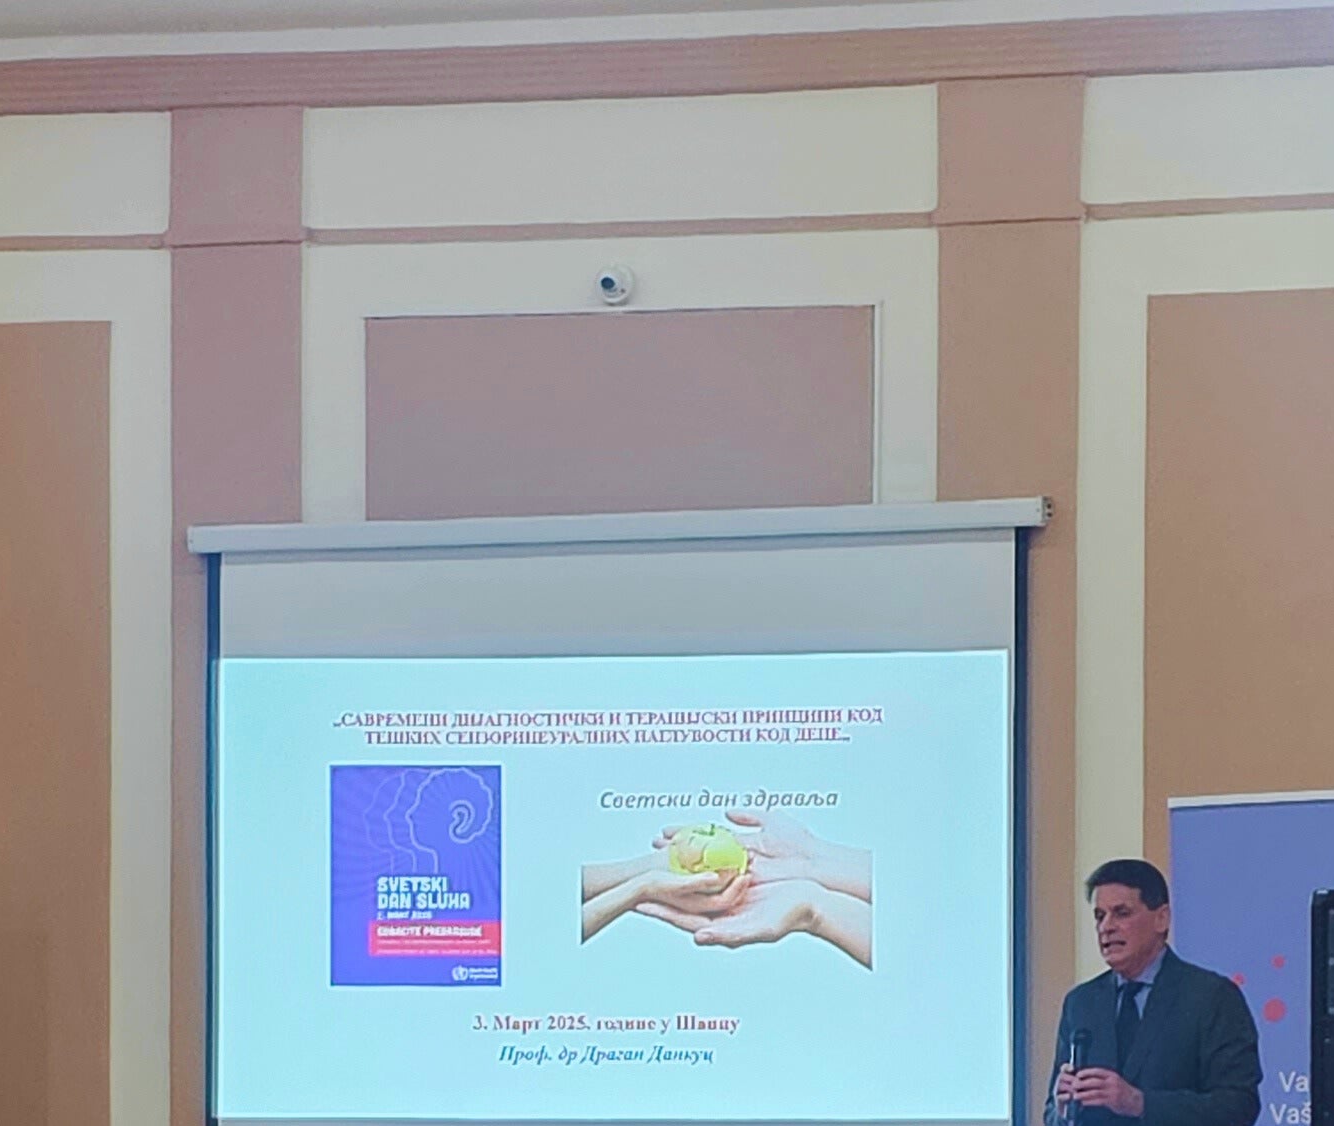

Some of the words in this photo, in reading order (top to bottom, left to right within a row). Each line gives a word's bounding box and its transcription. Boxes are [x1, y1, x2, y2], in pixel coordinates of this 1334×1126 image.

[610, 711, 621, 725] И
[847, 708, 883, 724] КОД
[756, 727, 791, 743] КОД
[600, 790, 692, 809] Светски
[698, 789, 737, 808] дан
[742, 788, 839, 812] здравља
[376, 876, 449, 892] SVETSKI
[377, 892, 412, 909] DAN
[416, 892, 471, 909] SLUHA
[472, 1015, 488, 1031] 3.
[493, 1015, 543, 1034] Март
[547, 1015, 591, 1031] 2025.
[596, 1018, 656, 1032] године
[660, 1019, 670, 1035] у
[498, 1045, 552, 1066] Проф.
[557, 1045, 577, 1066] др
[579, 1045, 644, 1065] Драган
[1278, 1071, 1310, 1093] Va
